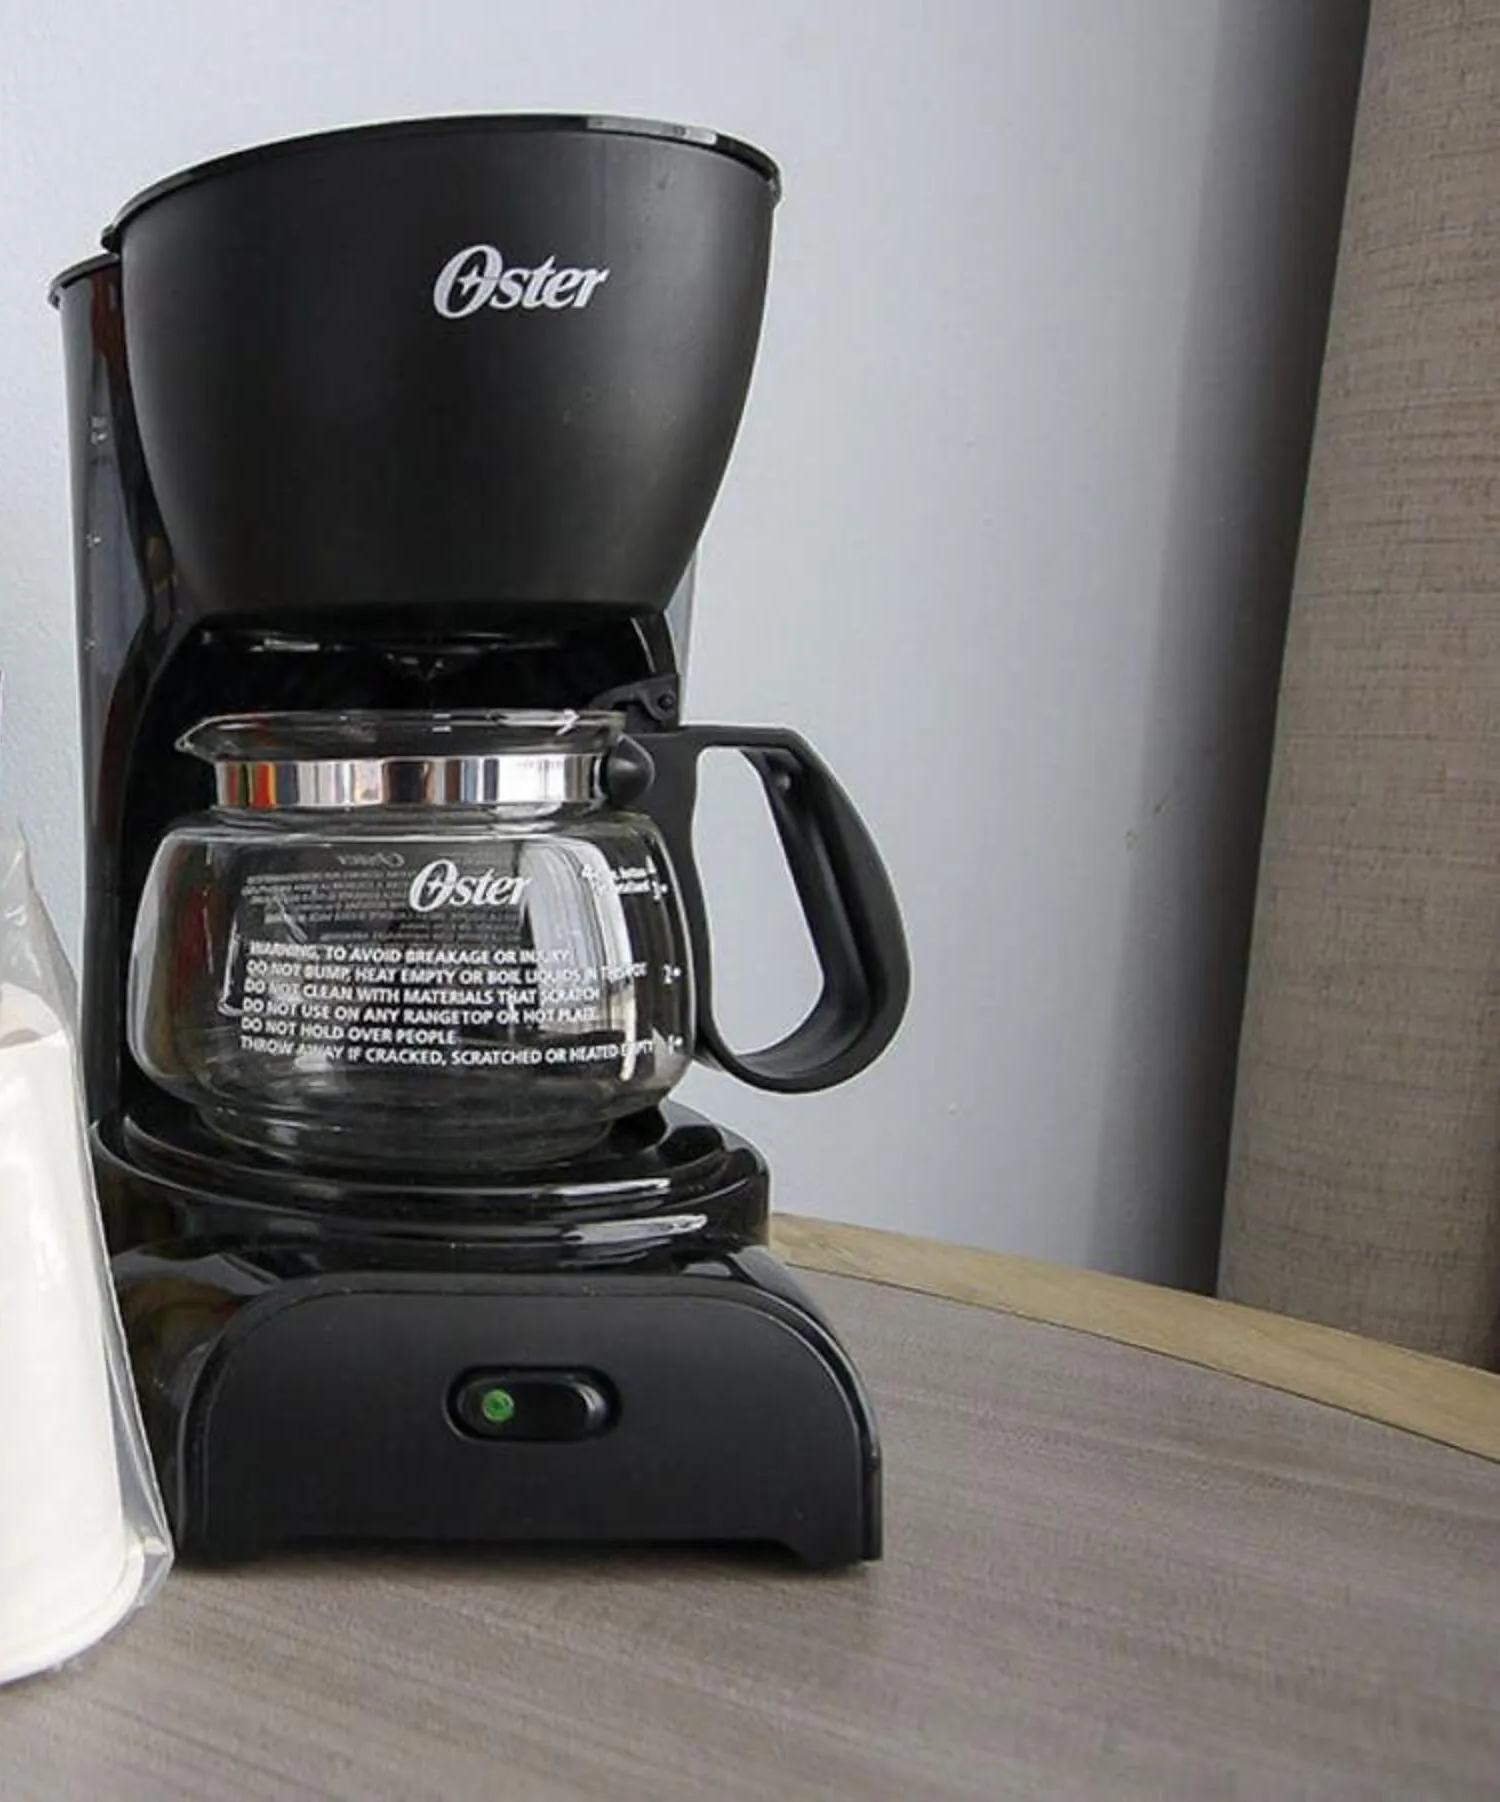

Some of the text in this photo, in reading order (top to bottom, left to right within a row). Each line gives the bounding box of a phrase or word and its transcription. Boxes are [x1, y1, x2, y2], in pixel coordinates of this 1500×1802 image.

[433, 244, 610, 319] Oster
[409, 858, 533, 912] Oster
[326, 945, 346, 960] TO
[349, 947, 402, 962] AVOID
[404, 949, 490, 964] BREAKAGE
[493, 950, 517, 964] OR
[246, 959, 267, 977] DO
[270, 961, 301, 977] NOT
[354, 966, 397, 982] HEAT
[401, 969, 455, 984] EMPTY
[459, 970, 484, 985] OR
[486, 969, 522, 985] BOIL
[244, 978, 265, 994] DO
[269, 981, 300, 996] NOT
[303, 984, 353, 1000] CLEAN
[356, 987, 400, 1003] WITH
[403, 988, 493, 1004] MATERIALS
[497, 989, 536, 1004] THAT
[243, 997, 264, 1013] DO
[266, 1000, 297, 1016] NOT
[301, 1003, 330, 1019] USE
[334, 1006, 360, 1020] ON
[363, 1007, 400, 1022] ANY
[496, 1009, 520, 1024] OR
[523, 1009, 555, 1024] HOT
[241, 1017, 457, 1044] DO NOT HOLD OVER PEOPLE
[240, 1035, 295, 1055] THROW
[348, 1046, 361, 1061] IF
[365, 1047, 447, 1066] CRACKED,
[451, 1049, 543, 1065] SCRATCHED
[545, 1049, 568, 1064] OR
[569, 1043, 619, 1062] HEATED
